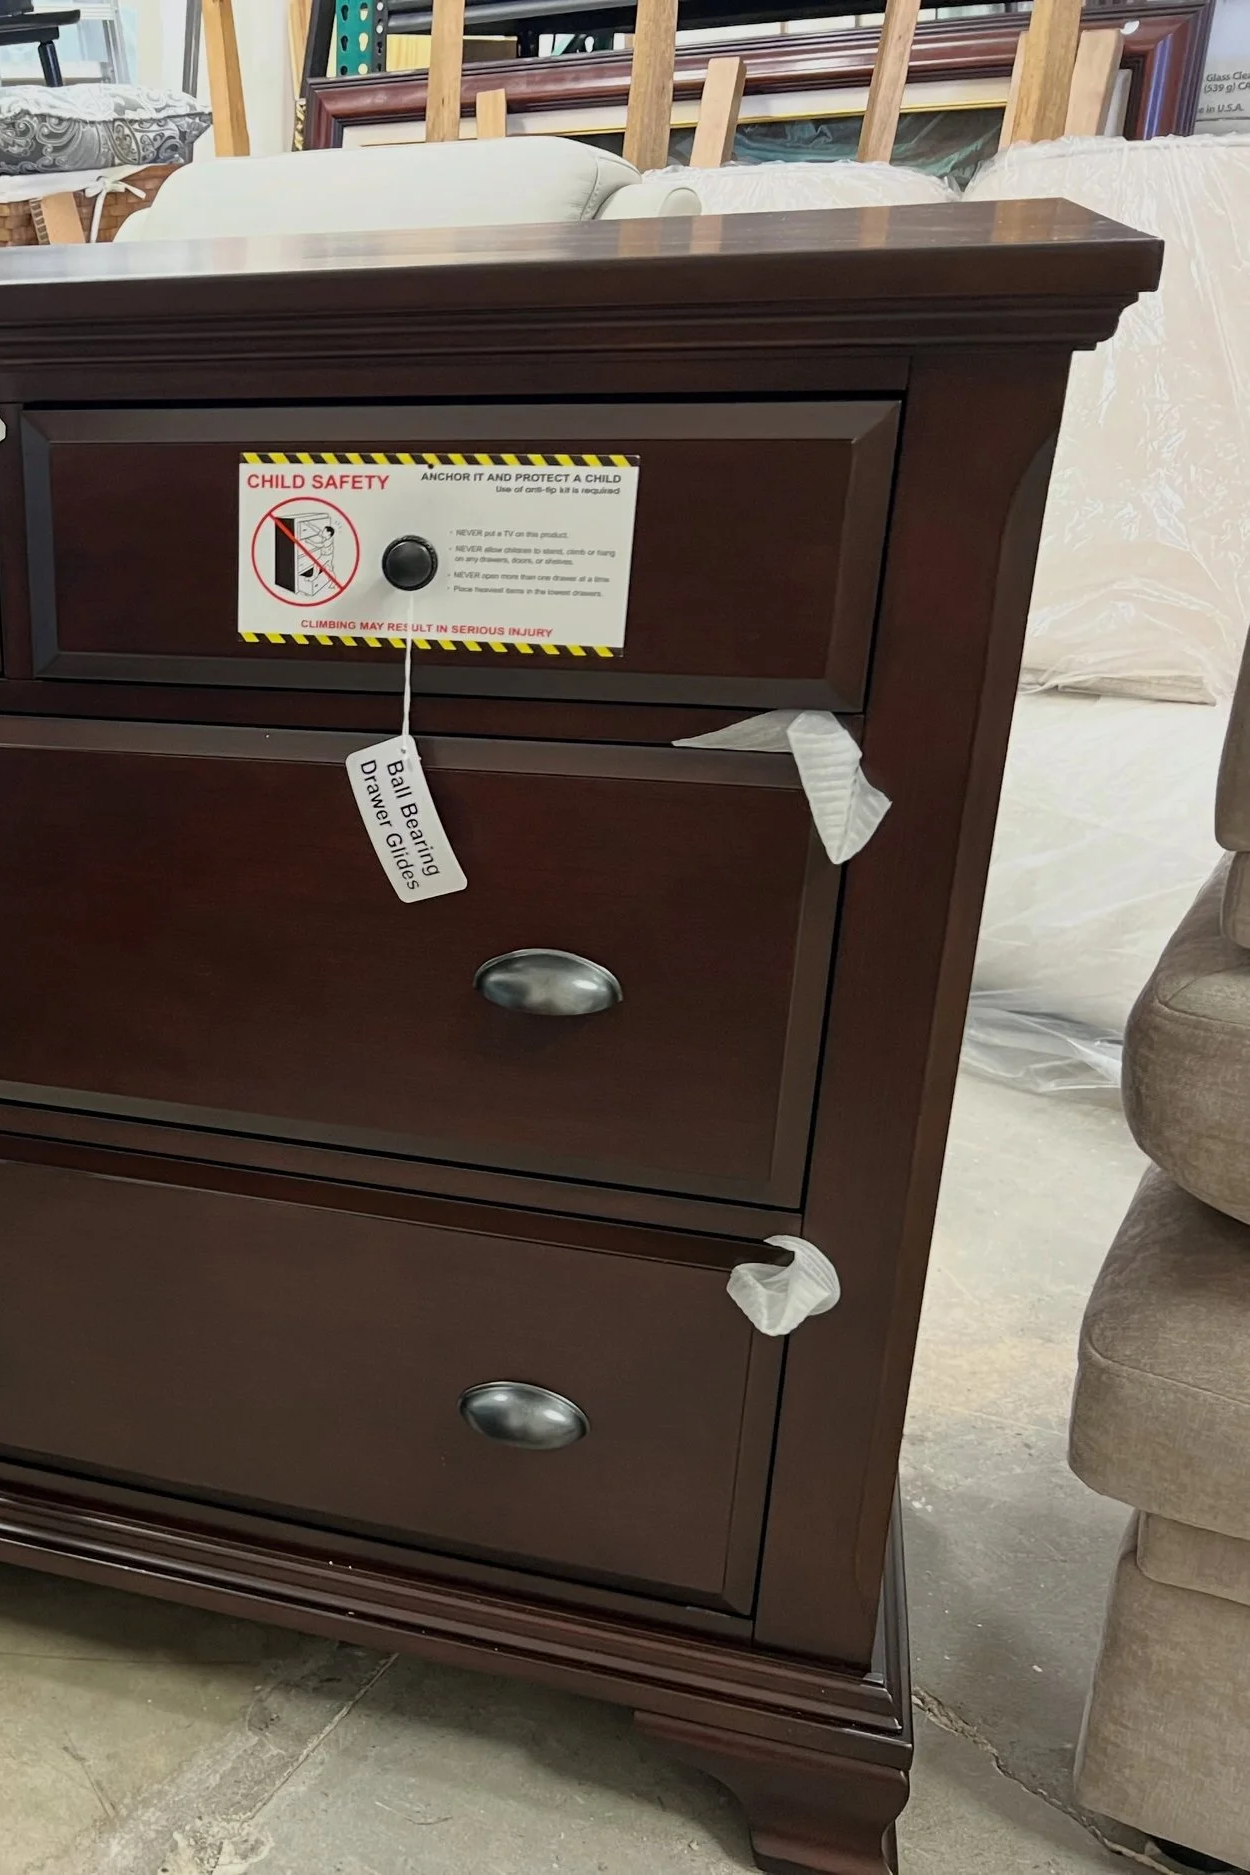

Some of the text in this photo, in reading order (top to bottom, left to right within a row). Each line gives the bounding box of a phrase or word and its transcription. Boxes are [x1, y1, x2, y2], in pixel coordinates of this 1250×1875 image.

[1206, 73, 1230, 82] Glass
[1204, 83, 1224, 94] (539
[1226, 82, 1236, 93] g)
[1206, 104, 1215, 113] in
[247, 474, 389, 490] CHILD SAFETY
[421, 472, 622, 484] ANCHOR IT AND PROTECT A CHILD
[496, 485, 512, 493] Use
[514, 485, 523, 493] of
[525, 486, 557, 495] anti-tip
[559, 486, 570, 494] kit
[581, 487, 621, 495] required
[456, 529, 483, 537] NEVER
[484, 530, 496, 538] put
[455, 545, 483, 553] NEVER
[454, 571, 480, 579] NEVER
[301, 619, 356, 630] CLIMBING
[360, 621, 384, 631] MAY
[436, 624, 448, 633] IN
[451, 625, 505, 635] SERIOUS
[508, 627, 553, 638] INJURY
[387, 760, 441, 877] Ball Bearing
[360, 760, 420, 890] Drawer Glides
